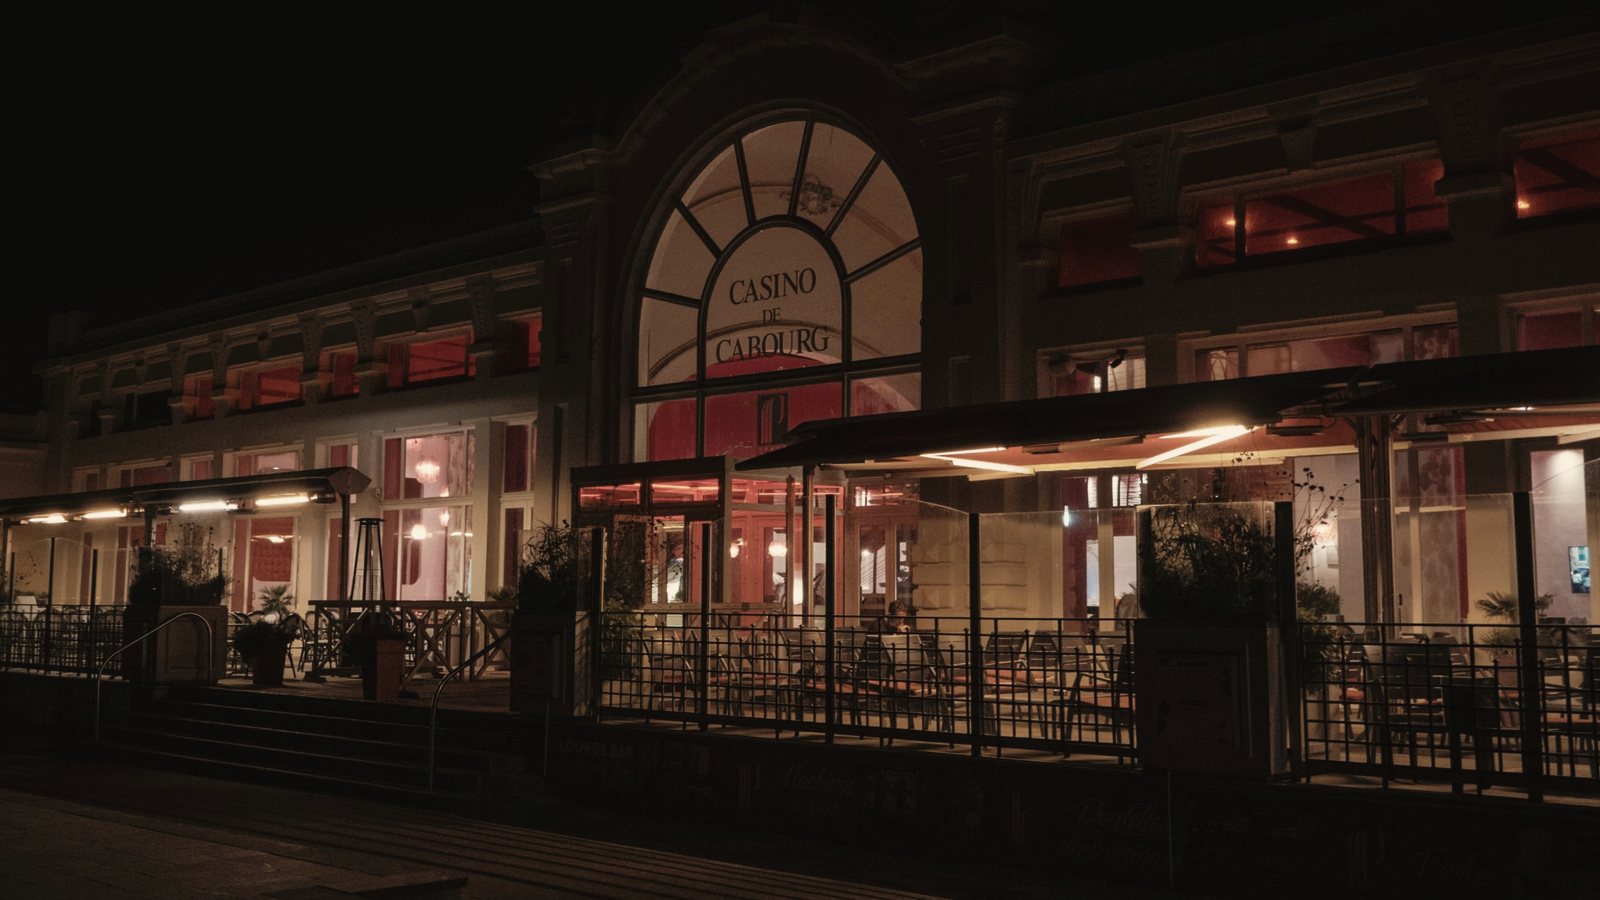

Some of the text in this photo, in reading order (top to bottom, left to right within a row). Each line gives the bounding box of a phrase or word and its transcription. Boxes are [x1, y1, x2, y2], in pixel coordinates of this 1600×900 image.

[729, 267, 817, 305] CASINO
[763, 308, 781, 324] DE
[717, 326, 829, 363] CABOURG
